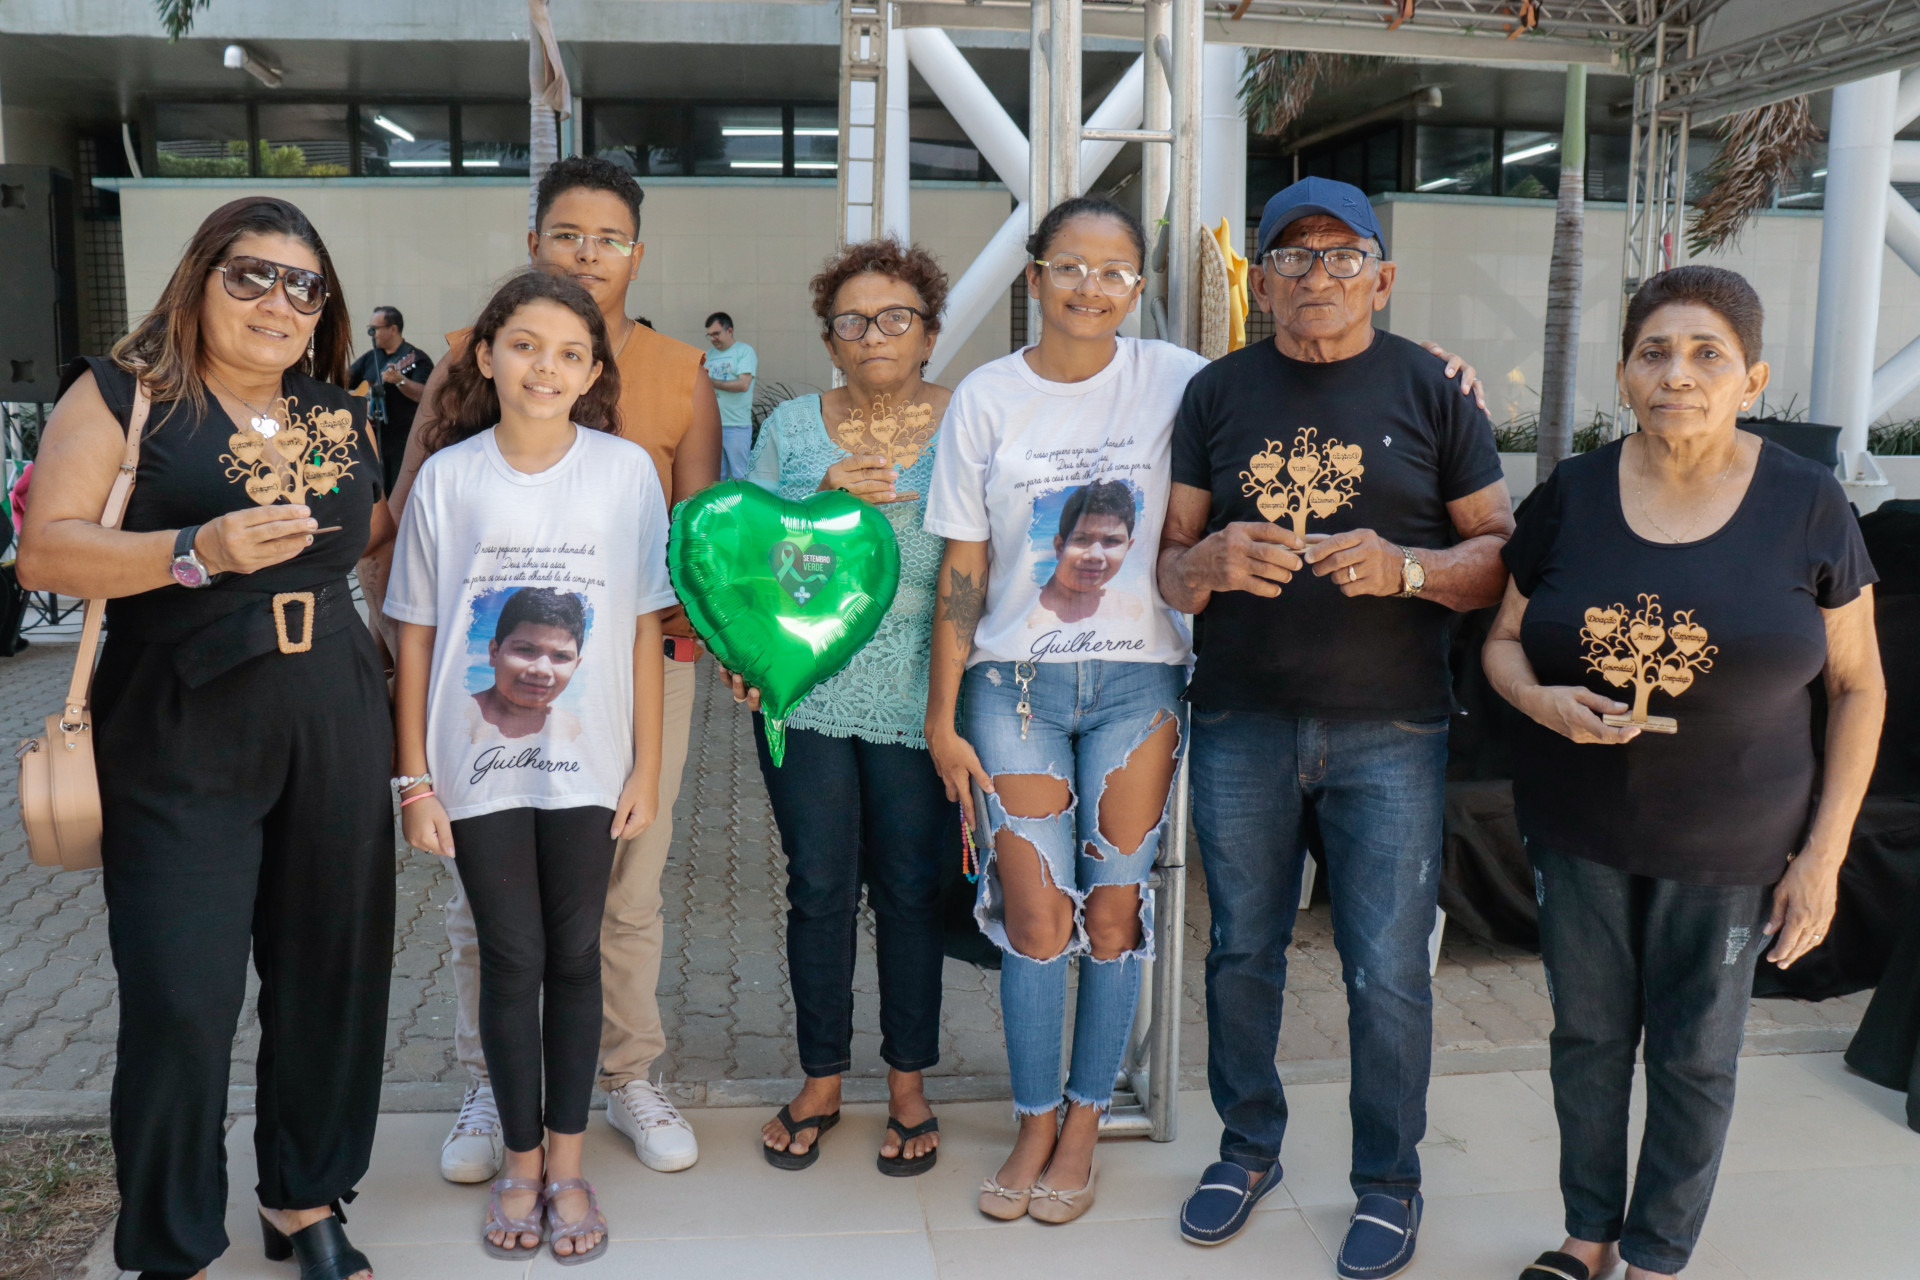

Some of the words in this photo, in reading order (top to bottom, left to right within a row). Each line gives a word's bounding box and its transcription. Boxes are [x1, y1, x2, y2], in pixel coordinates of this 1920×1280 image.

[1025, 449, 1033, 461] O
[1026, 477, 1043, 493] para
[474, 542, 482, 555] O
[803, 554, 830, 564] SETEMBRO
[803, 562, 824, 572] VERDE
[1588, 614, 1618, 625] Doação
[1633, 632, 1660, 642] Amor
[1028, 630, 1146, 662] Guilherme
[469, 745, 580, 785] Guilherme
